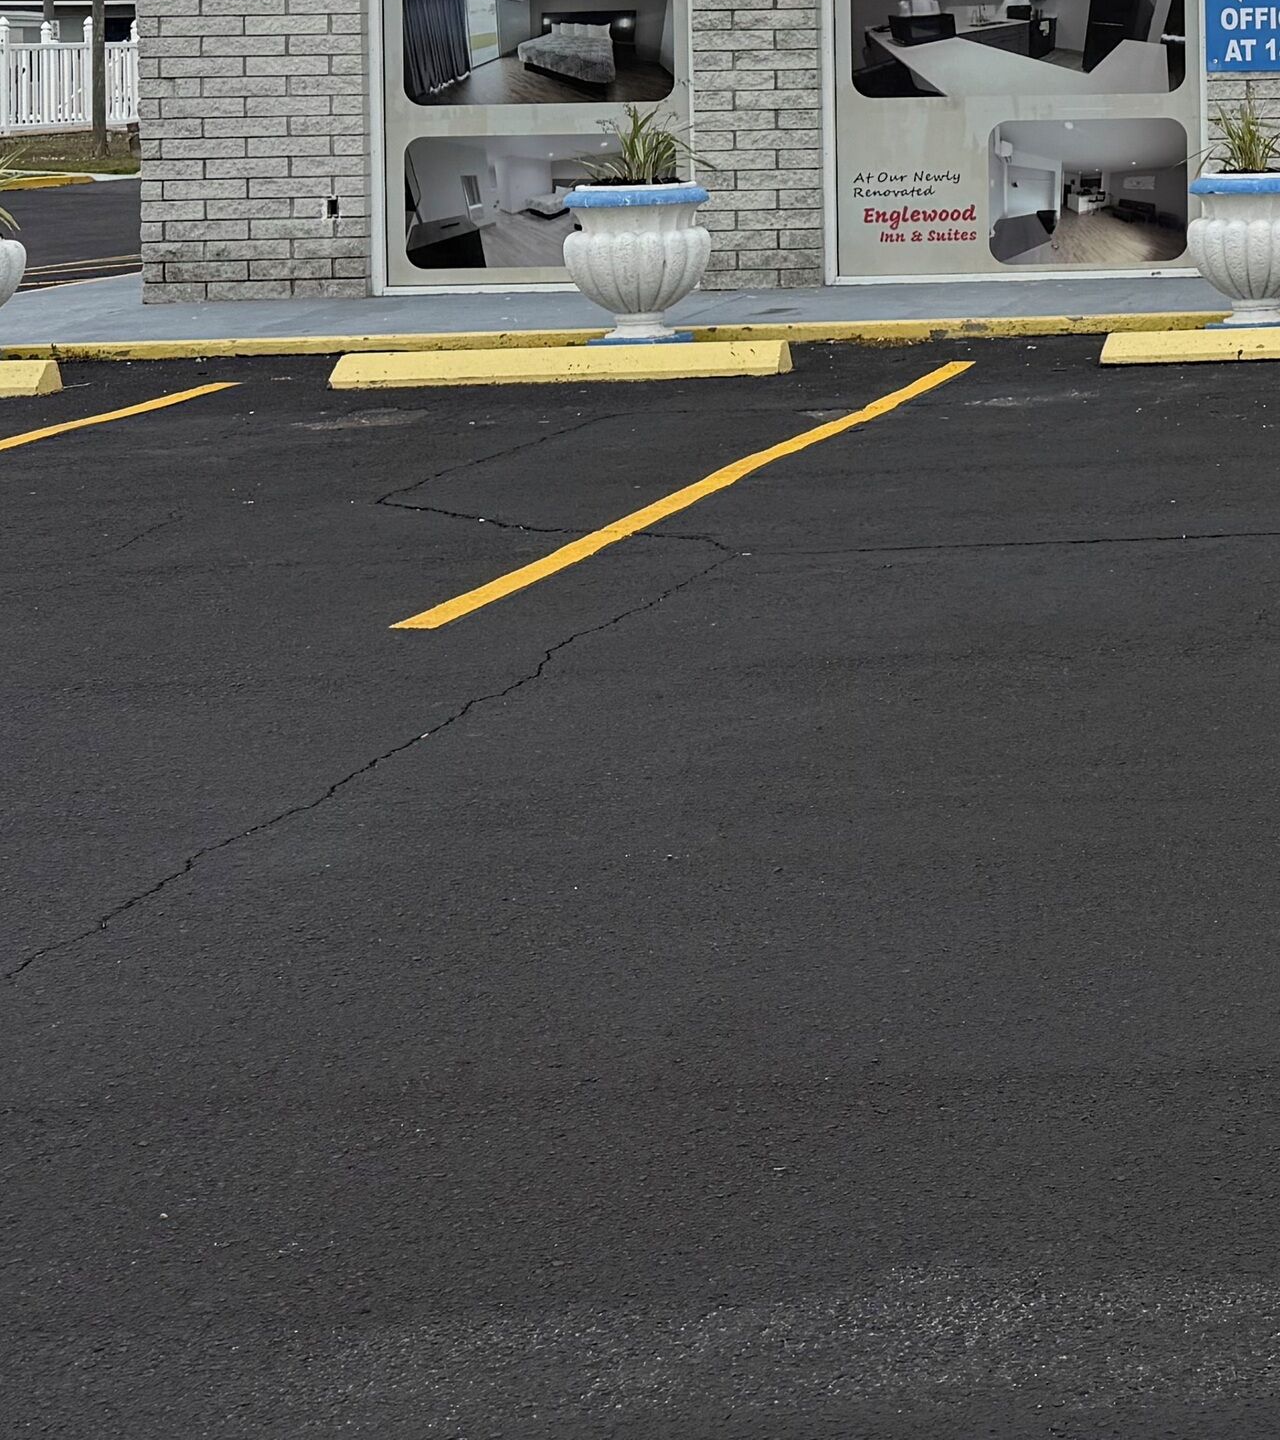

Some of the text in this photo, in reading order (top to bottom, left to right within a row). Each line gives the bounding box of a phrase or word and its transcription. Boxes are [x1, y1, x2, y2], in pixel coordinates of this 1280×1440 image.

[1225, 39, 1257, 61] AT
[853, 171, 960, 183] At Our Newly
[853, 185, 935, 198] Renovated
[864, 204, 976, 230] Englewood
[880, 229, 977, 243] Inn & Suites
